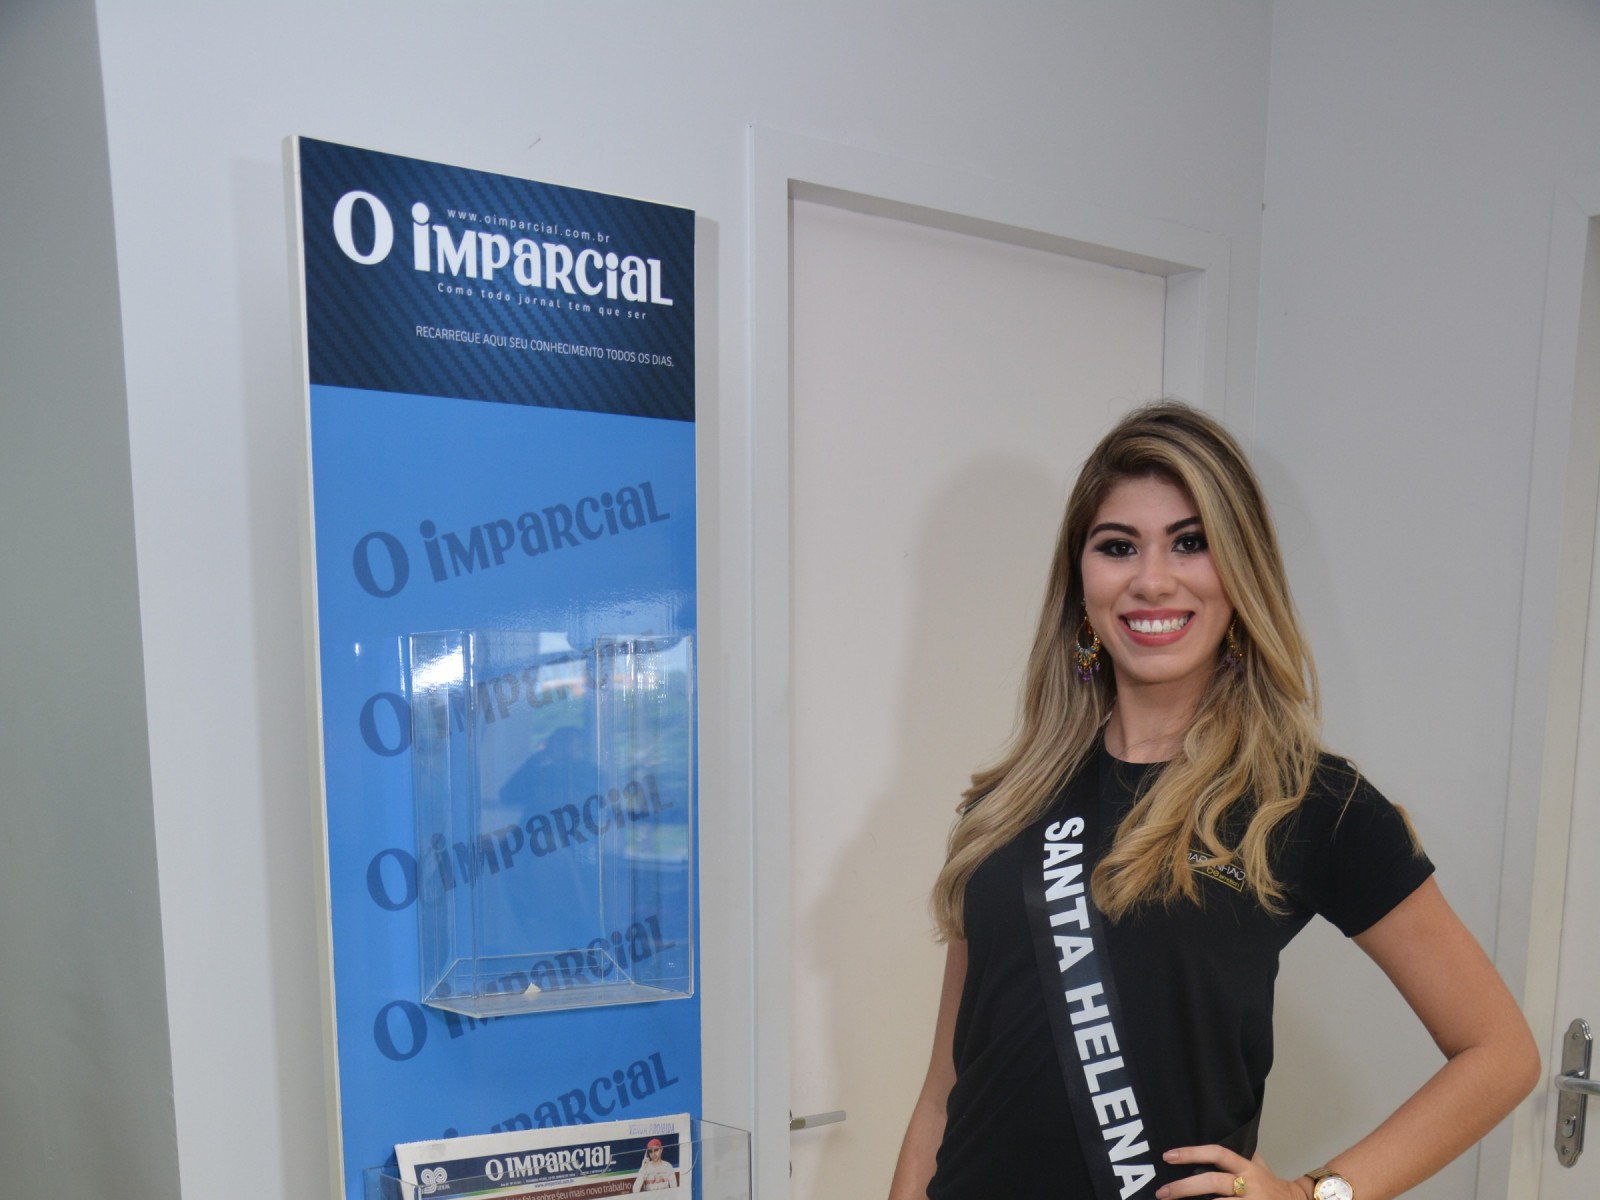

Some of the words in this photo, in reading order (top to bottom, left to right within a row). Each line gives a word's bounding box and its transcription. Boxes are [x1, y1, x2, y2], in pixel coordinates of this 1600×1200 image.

[333, 190, 394, 265] O
[447, 209, 610, 243] www.oimparcial.com.br
[438, 283, 473, 297] Como
[481, 290, 511, 302] todo
[518, 294, 561, 309] jornal
[569, 302, 591, 313] tem
[598, 306, 620, 317] que
[627, 310, 647, 320] ser
[416, 325, 481, 345] RECARREGUE
[483, 335, 507, 348] AQUI
[509, 337, 528, 350] SEU
[530, 339, 604, 359] CONHECIMENTO
[605, 348, 636, 363] TODOS
[637, 352, 650, 364] OS
[651, 354, 674, 368] DIAS.
[353, 531, 410, 599] O
[359, 692, 412, 757] O
[366, 848, 419, 911] O
[1043, 816, 1095, 973] SANTA
[373, 1000, 428, 1061] O
[1065, 982, 1157, 1200] HELENA
[485, 1159, 504, 1181] O
[556, 1190, 568, 1199] seu
[569, 1188, 585, 1198] mais
[586, 1186, 602, 1196] novo
[603, 1182, 632, 1193] trabalho
